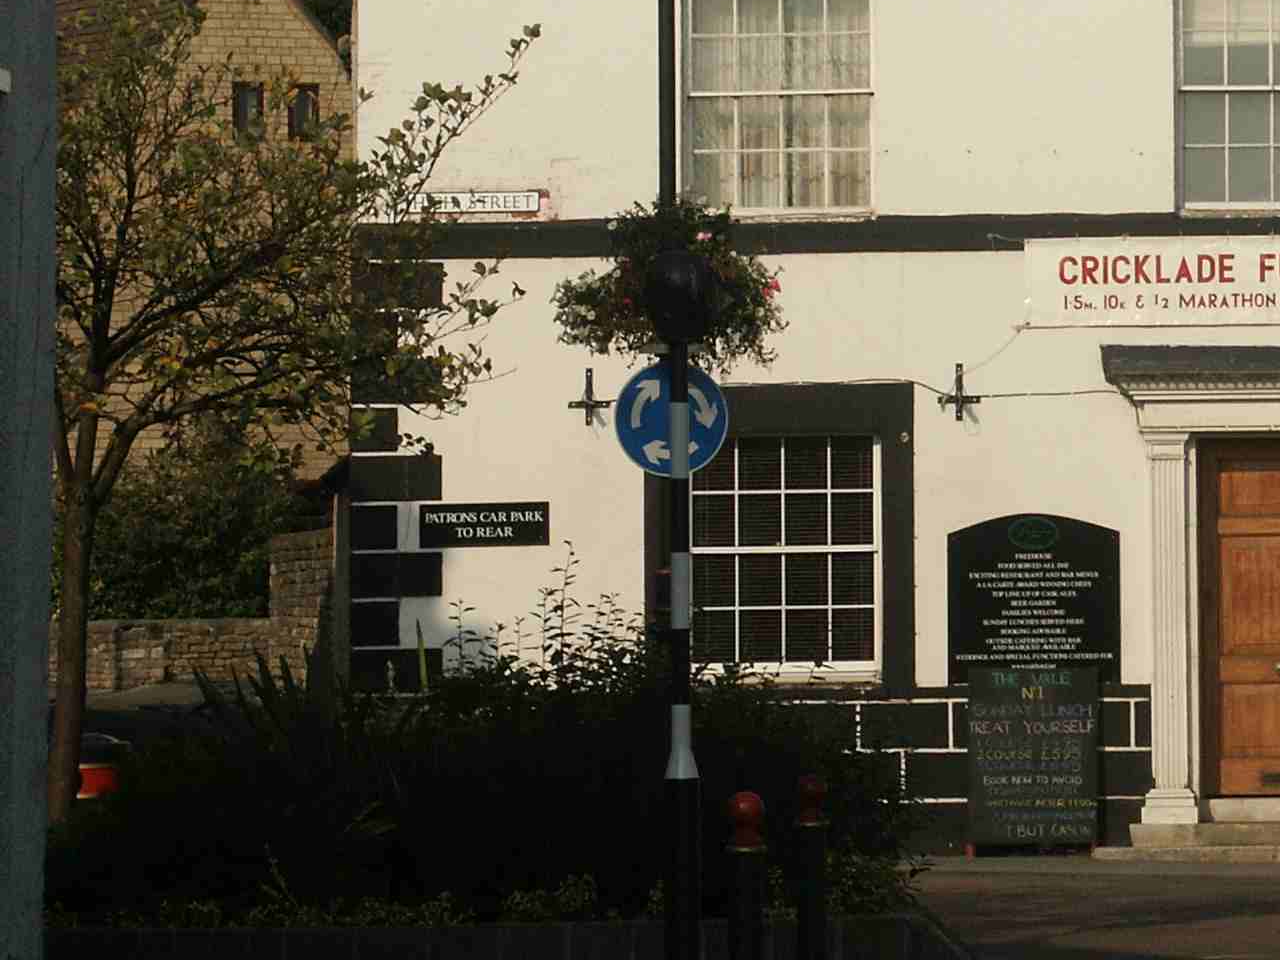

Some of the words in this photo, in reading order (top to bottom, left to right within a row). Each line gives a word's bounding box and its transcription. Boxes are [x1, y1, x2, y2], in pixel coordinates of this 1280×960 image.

[468, 194, 533, 209] STREET
[1058, 254, 1236, 285] CRICKLADE
[1178, 292, 1277, 310] MARATHON
[424, 511, 478, 524] PATRONS
[479, 511, 507, 523] CAR
[510, 510, 544, 522] PARK
[455, 526, 474, 538] TO
[476, 526, 515, 538] REAR
